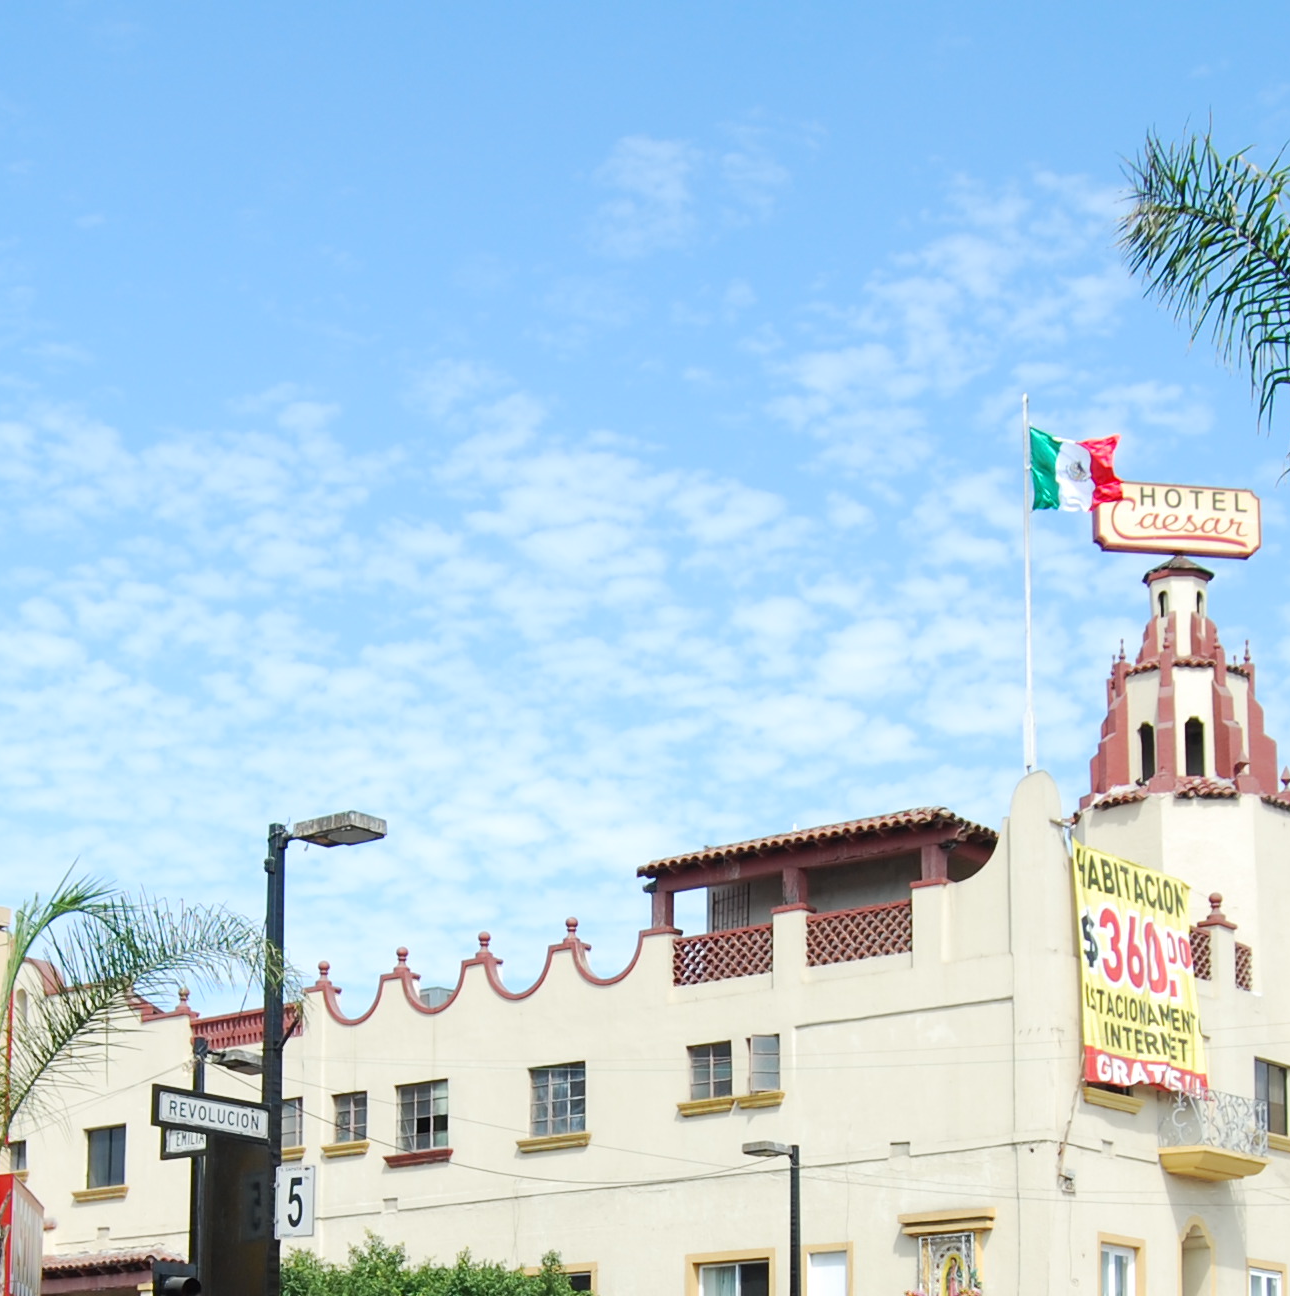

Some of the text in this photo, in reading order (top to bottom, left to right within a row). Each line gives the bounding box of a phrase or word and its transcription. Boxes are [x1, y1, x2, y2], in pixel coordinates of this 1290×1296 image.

[1111, 496, 1249, 549] Caesar
[1139, 486, 1248, 513] HOTEL
[1104, 1021, 1189, 1063] INTERNET
[287, 1176, 303, 1229] 5
